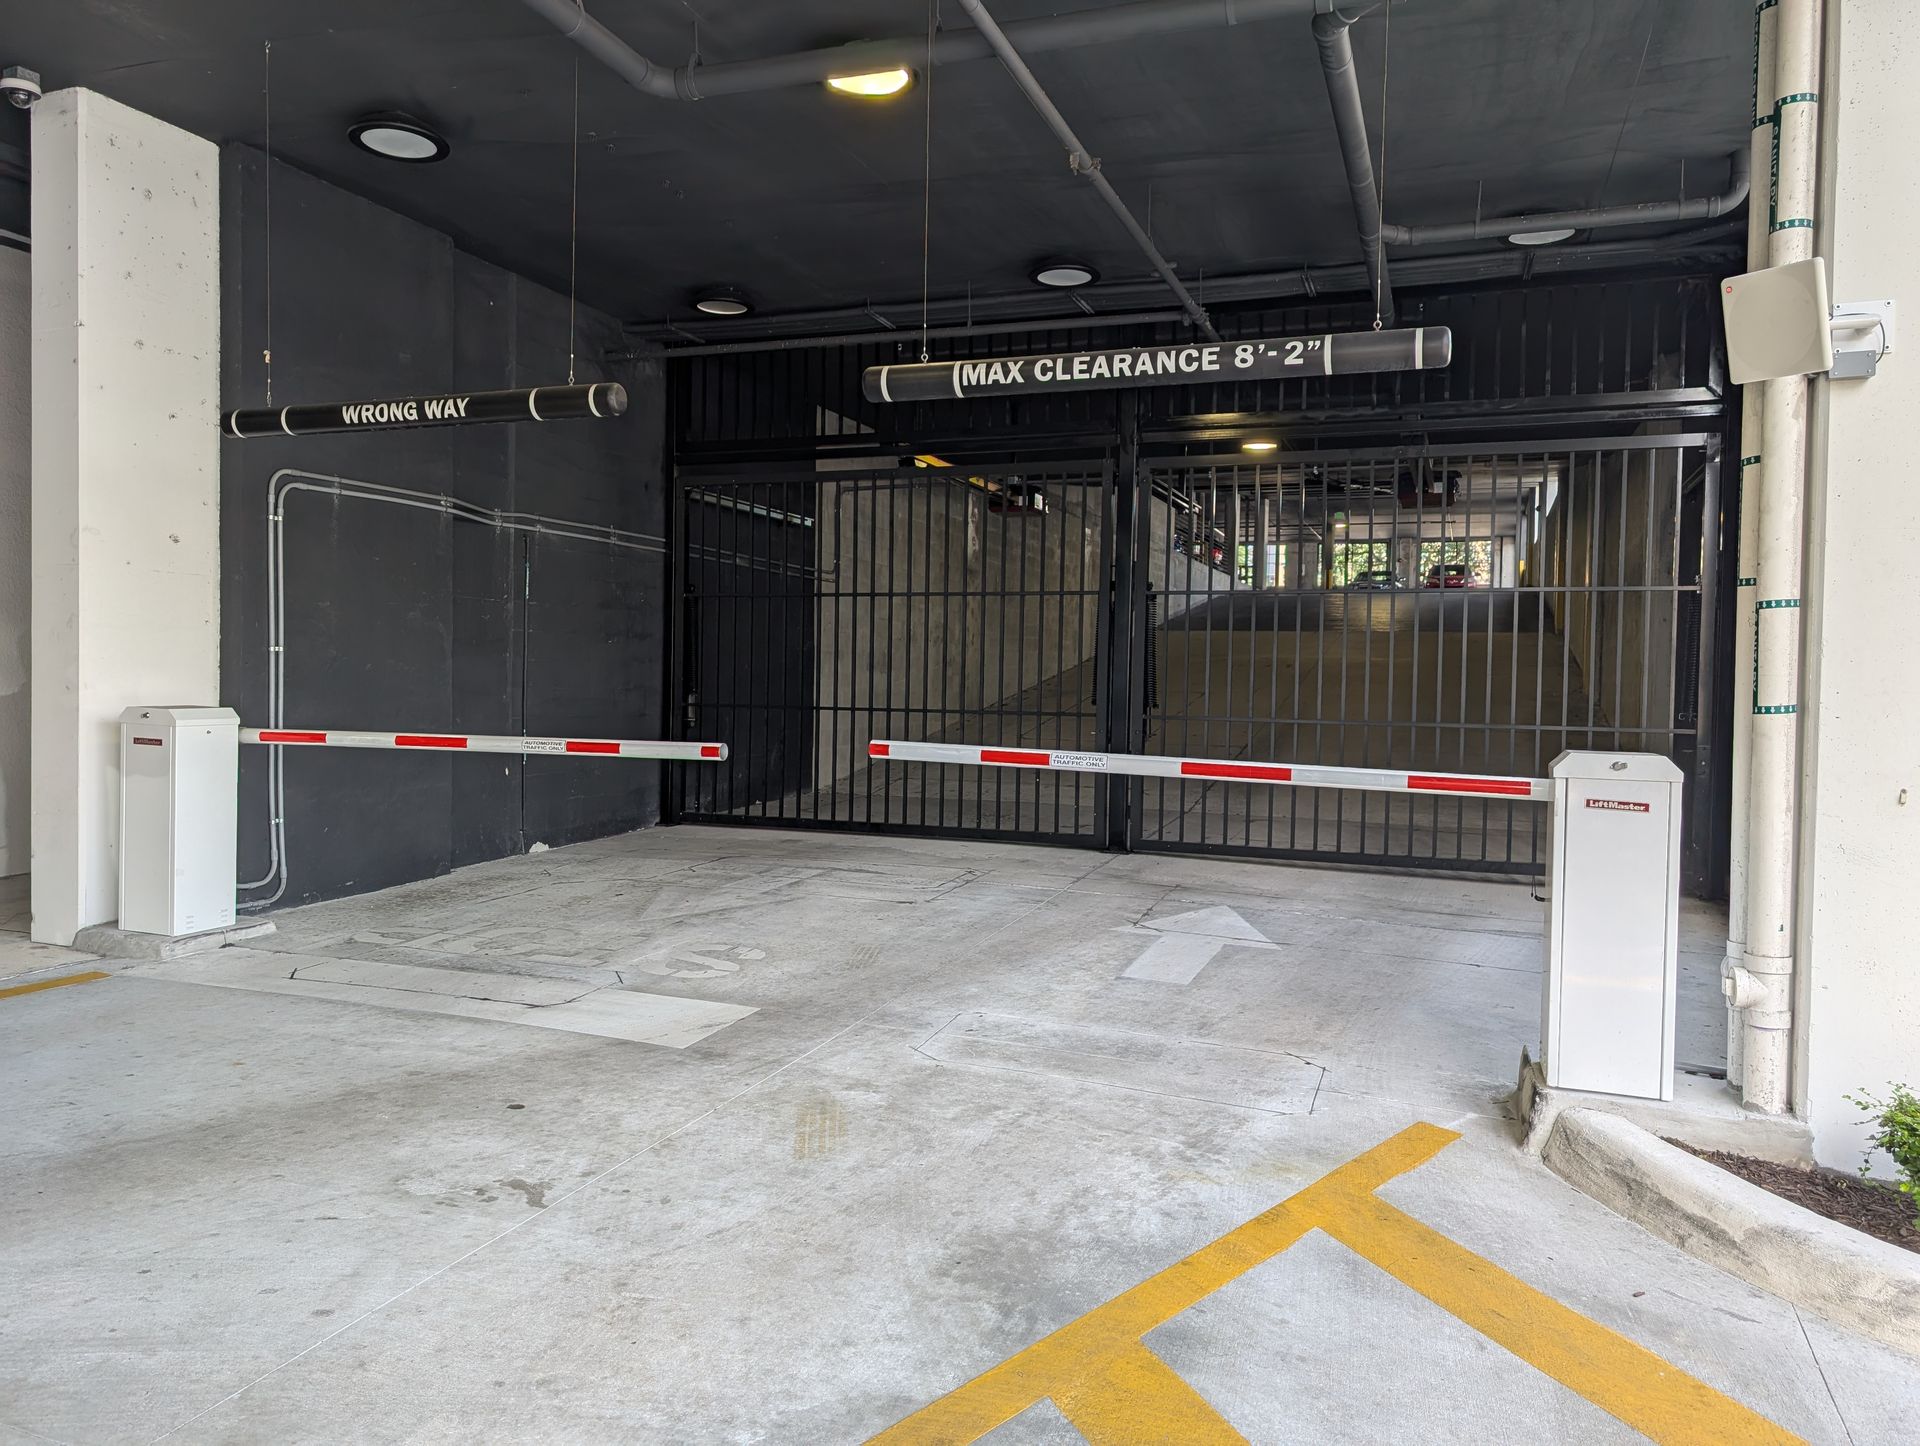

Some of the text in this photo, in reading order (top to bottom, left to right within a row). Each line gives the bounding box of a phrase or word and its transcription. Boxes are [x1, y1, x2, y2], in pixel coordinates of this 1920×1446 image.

[962, 360, 1024, 386] MAX
[1034, 347, 1221, 382] CLEARANCE
[342, 397, 470, 424] WRONG WAY
[1054, 754, 1104, 762] AUTOMOTIVE
[1589, 800, 1646, 810] LiftMaster
